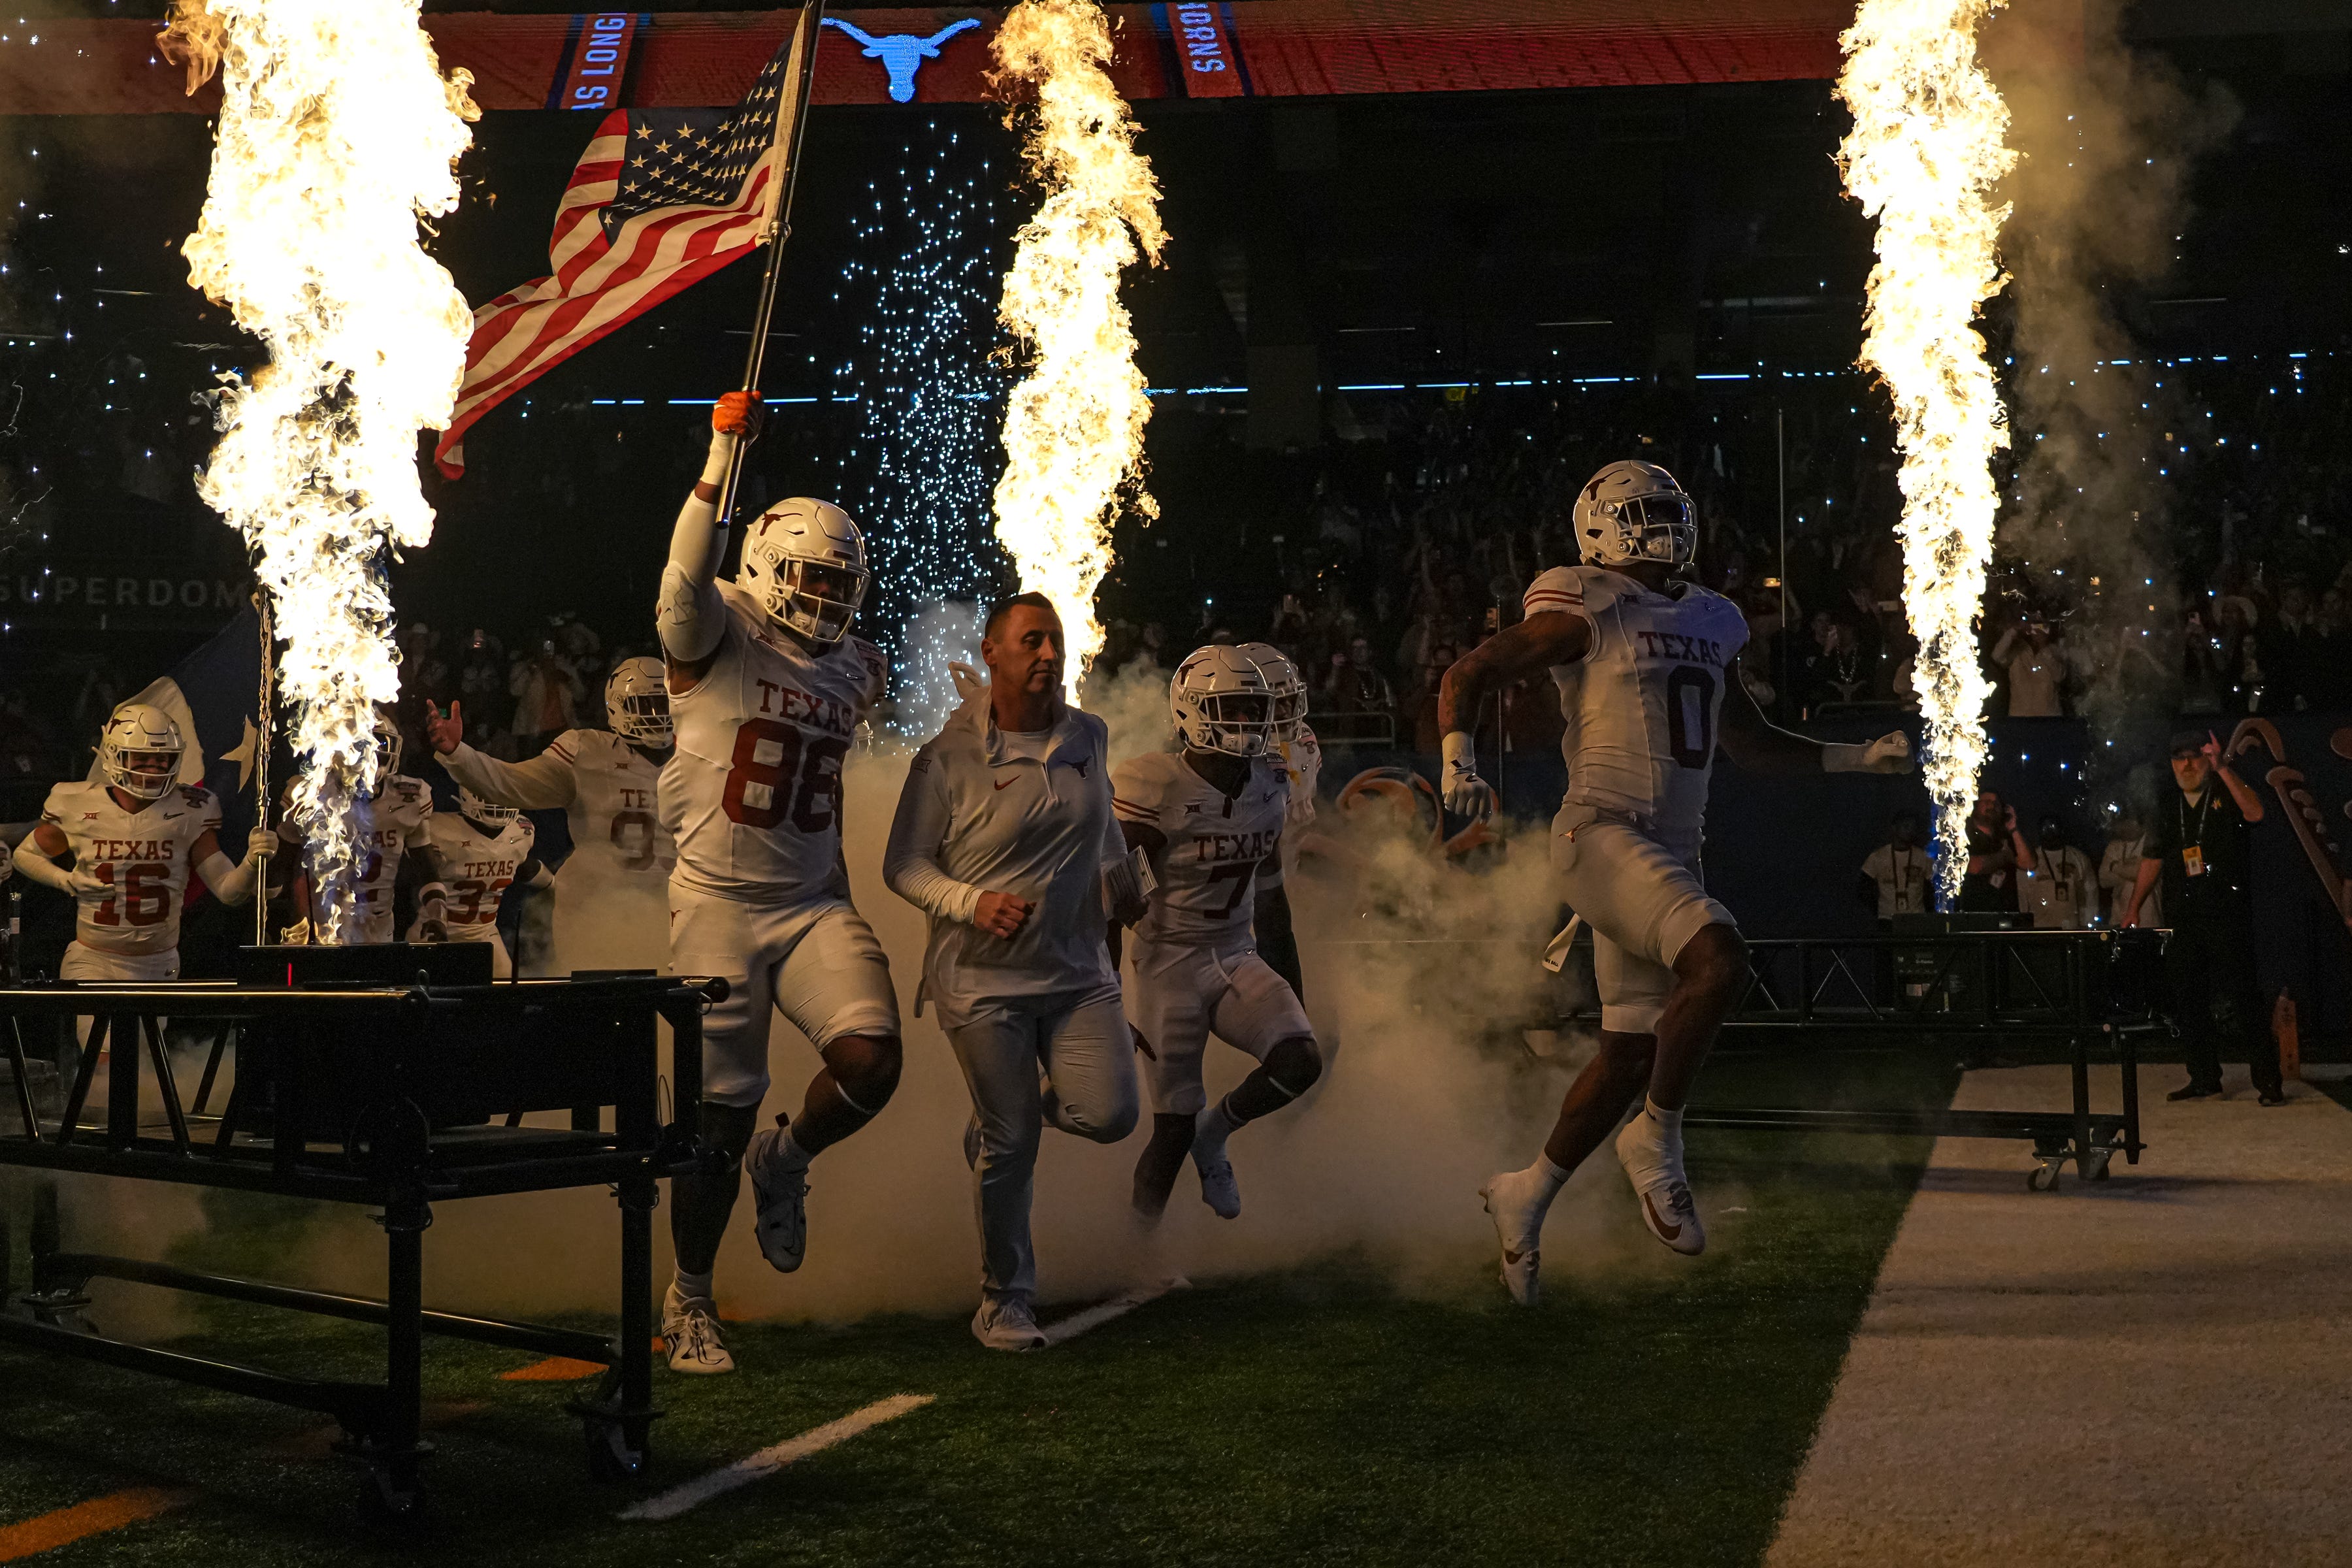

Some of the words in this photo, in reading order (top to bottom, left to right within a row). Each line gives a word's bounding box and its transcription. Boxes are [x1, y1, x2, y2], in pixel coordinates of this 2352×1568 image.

[580, 11, 627, 76] LONG
[1638, 631, 1723, 668] TEXAS
[757, 678, 853, 737] TEXAS
[1667, 665, 1716, 770] 0
[620, 789, 653, 808] TE
[721, 717, 849, 833] 88
[92, 840, 174, 860] TEXAS
[465, 860, 514, 878] TEXAS
[1194, 830, 1275, 862] TEXAS
[93, 862, 171, 926] 16
[1204, 861, 1259, 920] 7
